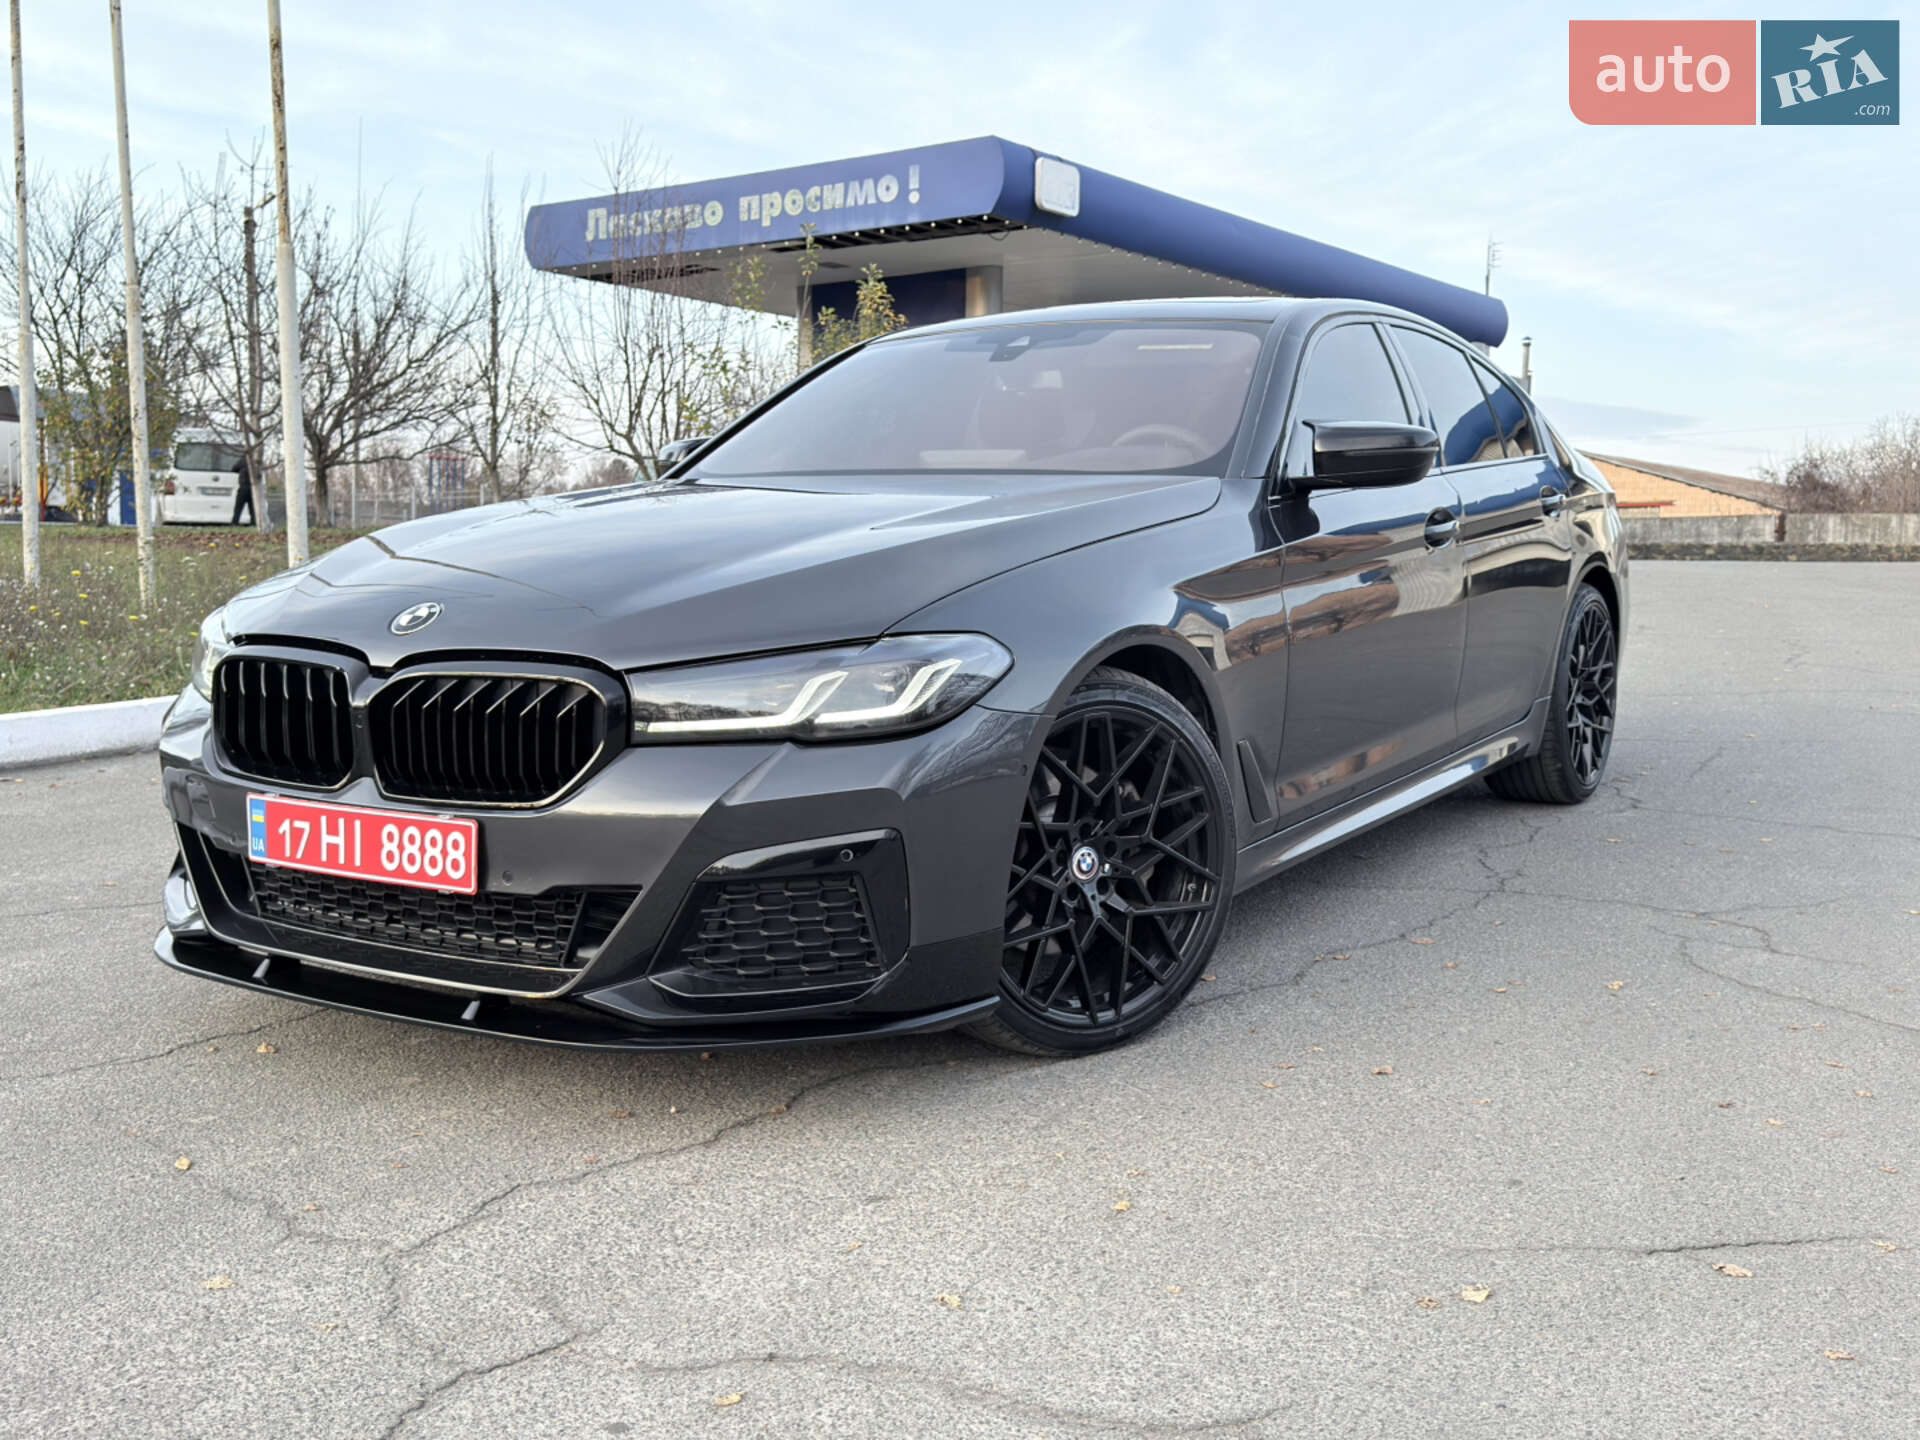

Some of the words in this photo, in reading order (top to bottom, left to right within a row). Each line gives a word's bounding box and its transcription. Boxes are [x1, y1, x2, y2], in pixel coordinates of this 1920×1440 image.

[252, 836, 265, 852] UA
[278, 818, 311, 860] 17
[380, 823, 467, 880] 8888
